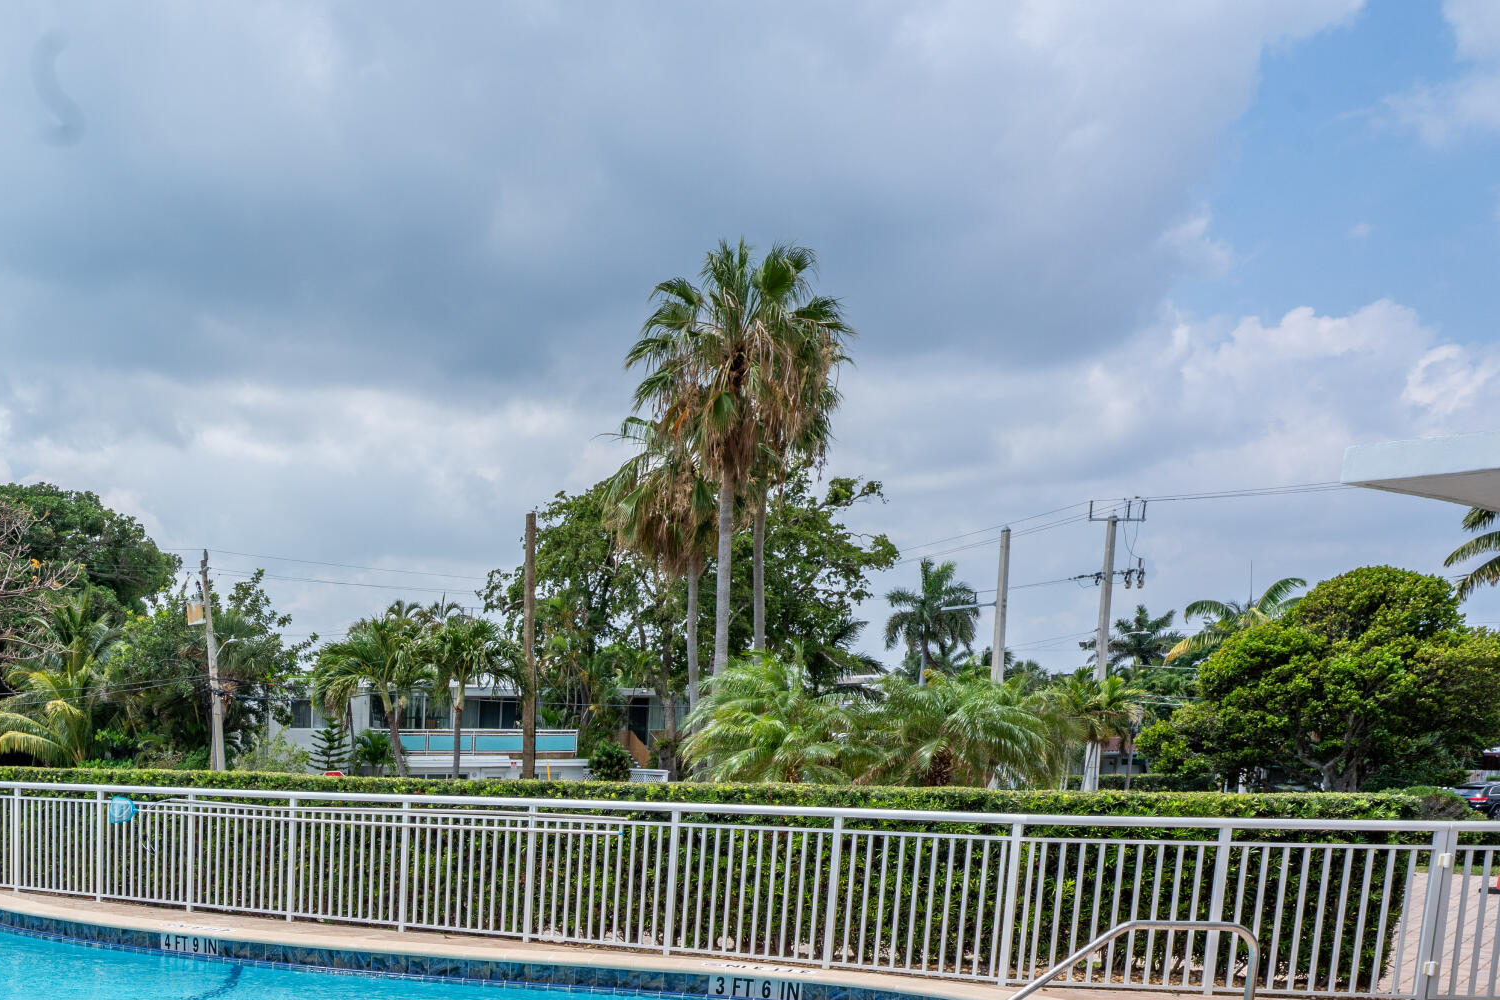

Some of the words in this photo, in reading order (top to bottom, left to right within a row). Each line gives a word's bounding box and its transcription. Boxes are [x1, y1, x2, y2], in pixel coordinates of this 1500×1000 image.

[165, 934, 170, 949] 4
[175, 936, 188, 952] FT
[192, 937, 198, 952] 9
[204, 938, 217, 954] IN
[716, 976, 724, 994] 3
[732, 978, 754, 997] FT
[762, 980, 771, 998] 6
[780, 982, 800, 1000] IN
